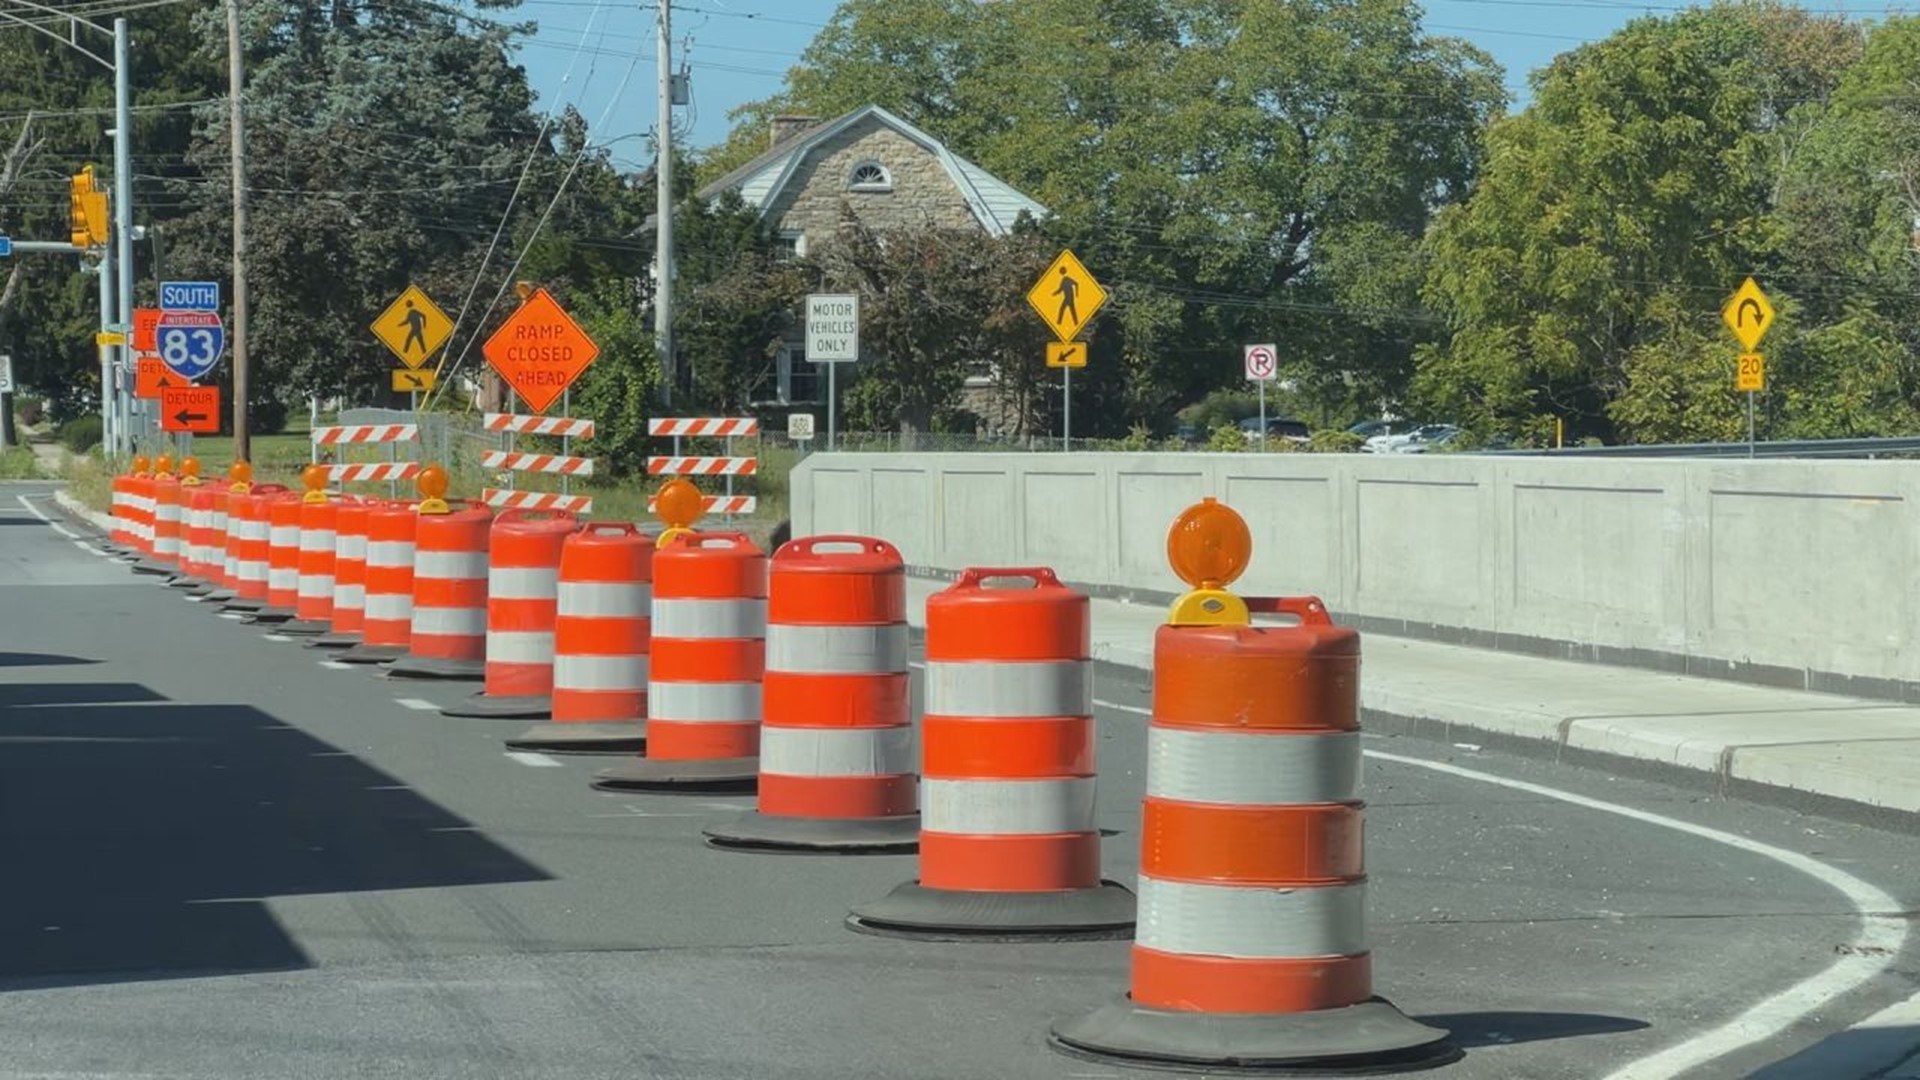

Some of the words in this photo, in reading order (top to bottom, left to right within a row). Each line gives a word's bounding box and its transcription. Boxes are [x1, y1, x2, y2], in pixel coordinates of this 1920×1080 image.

[165, 286, 215, 305] SOUTH
[813, 304, 853, 316] MOTOR
[166, 316, 212, 325] INTERSTATE
[810, 321, 854, 333] VEHICLES
[516, 325, 564, 338] RAMP
[164, 329, 215, 366] 83
[817, 339, 847, 352] ONLY
[507, 347, 573, 361] CLOSED
[1741, 358, 1760, 375] 20
[516, 371, 566, 385] AHEAD
[167, 393, 213, 405] DETOUR
